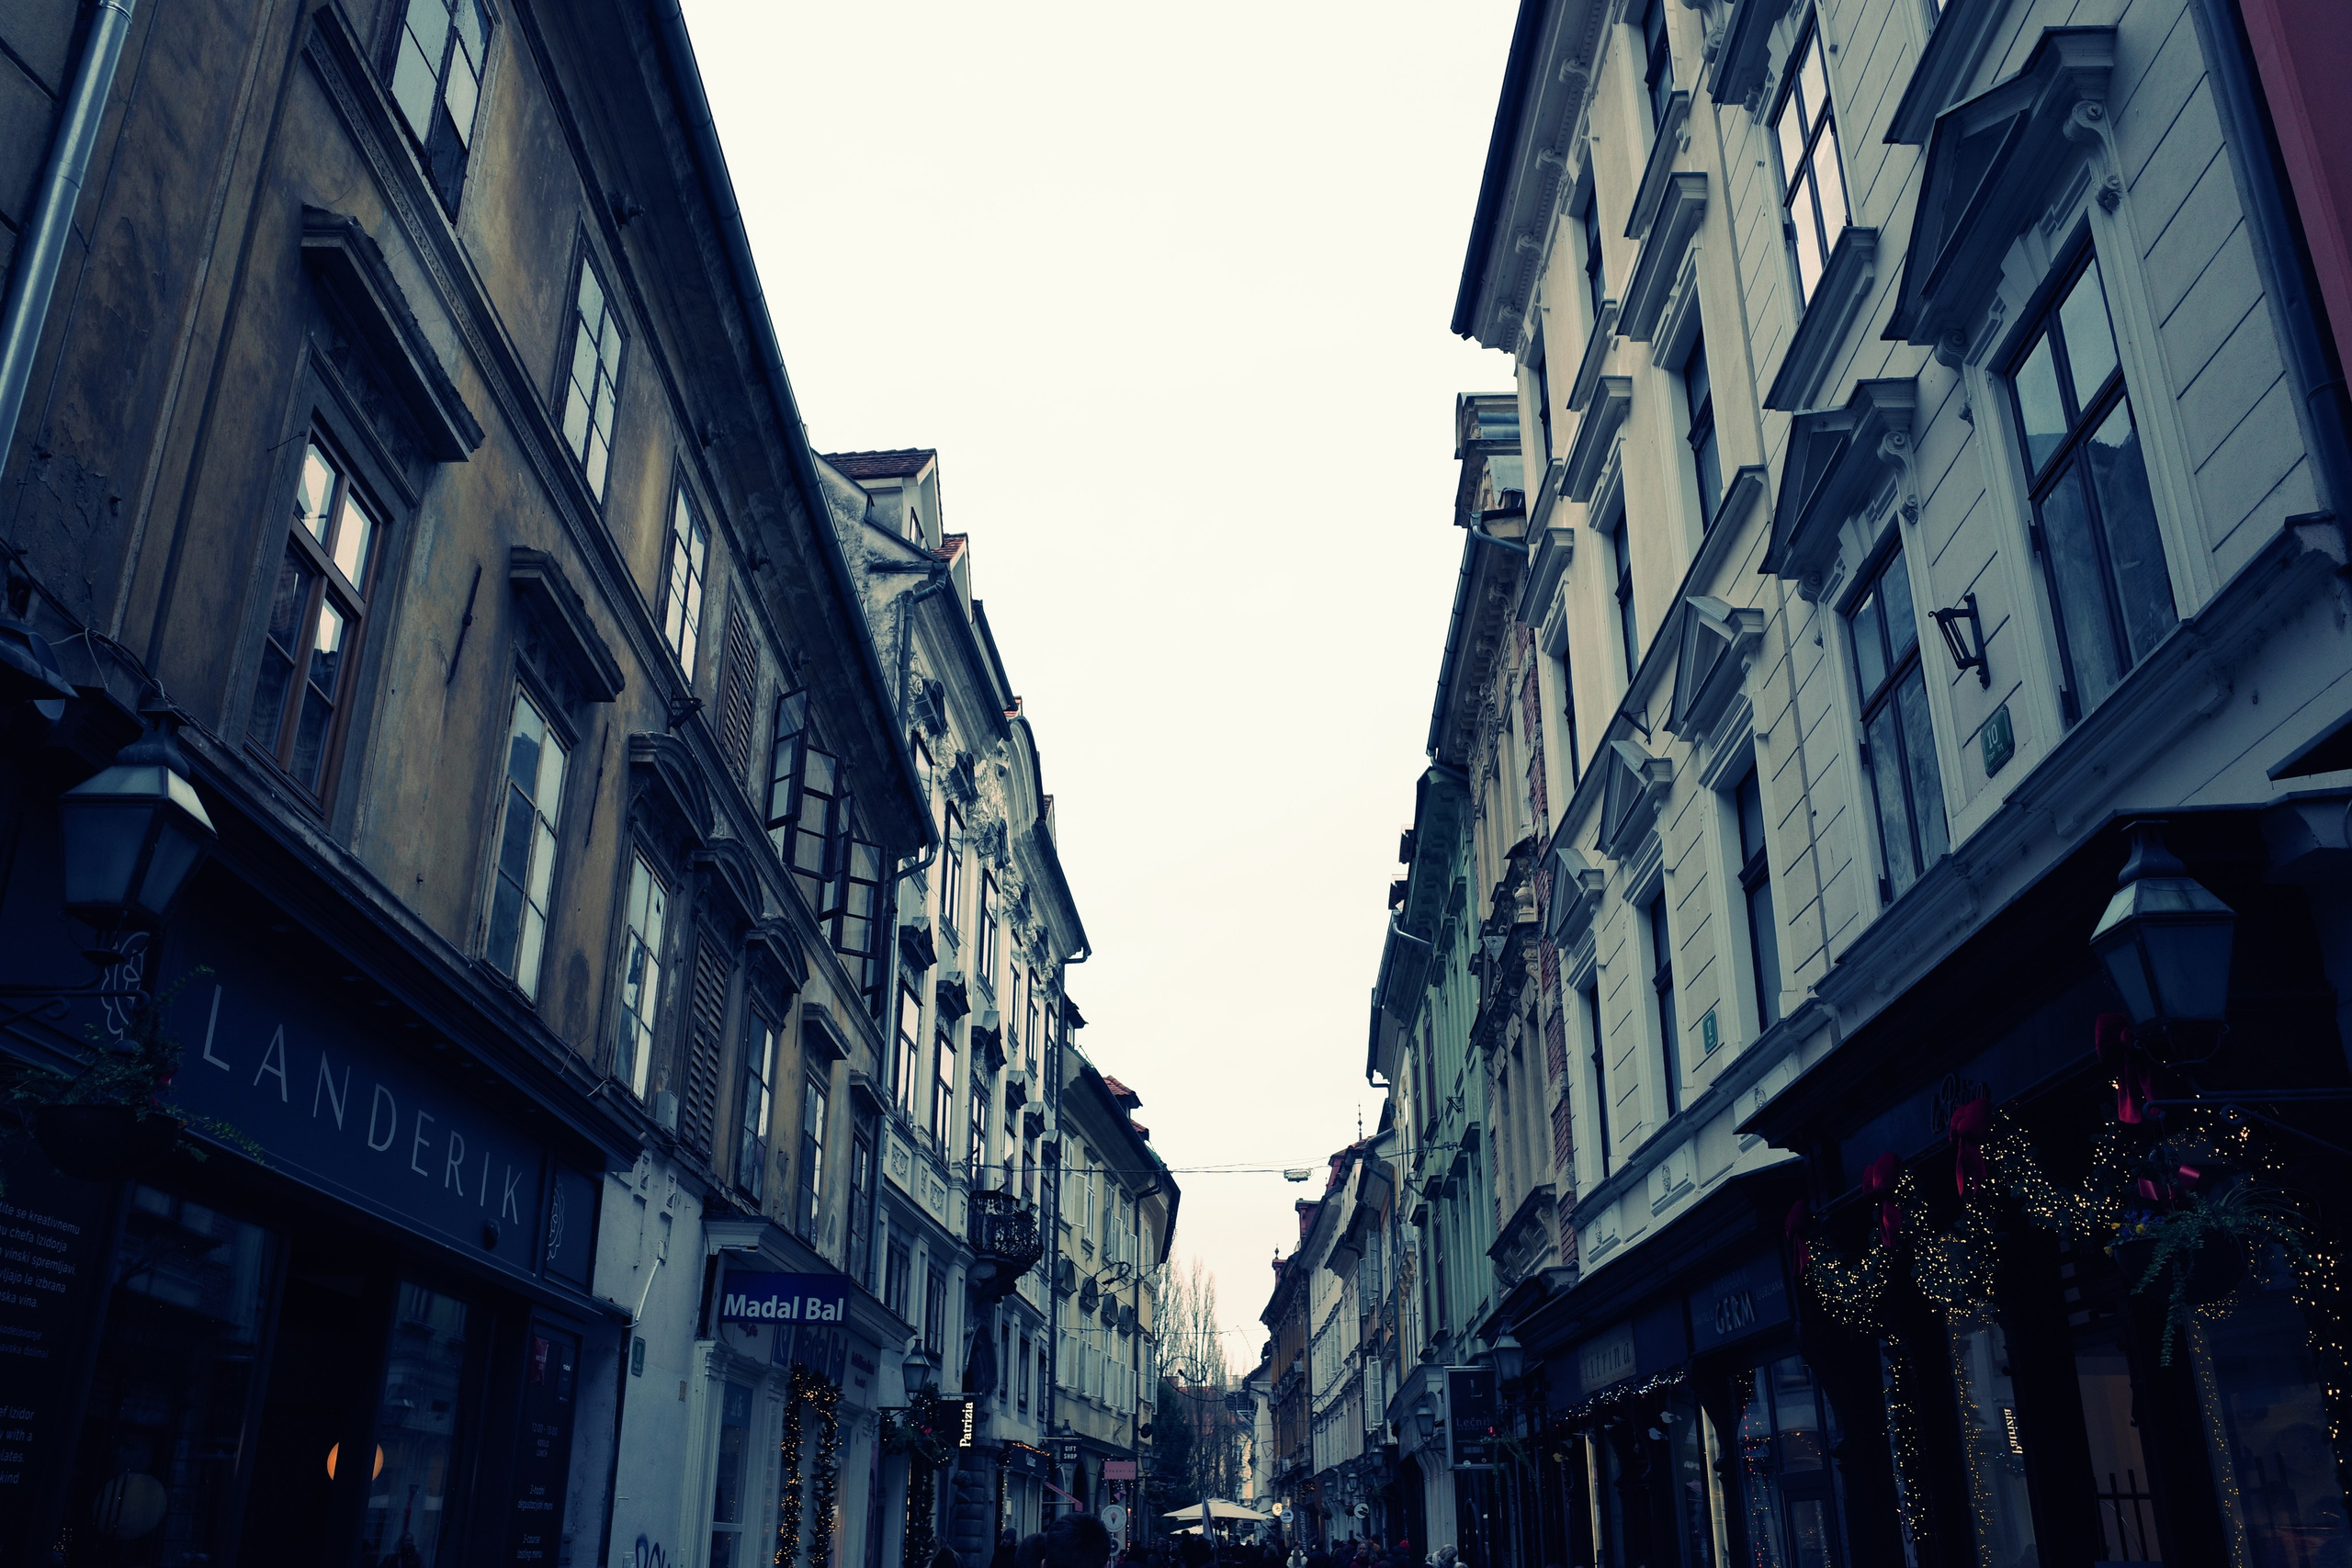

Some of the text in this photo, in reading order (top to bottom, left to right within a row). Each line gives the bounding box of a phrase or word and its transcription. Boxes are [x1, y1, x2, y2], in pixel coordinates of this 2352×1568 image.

[1987, 723, 1998, 749] 10
[201, 983, 523, 1226] LANDERIK
[16, 1208, 27, 1220] se
[28, 1209, 81, 1235] kreativnemu
[9, 1226, 34, 1243] chefa
[36, 1233, 67, 1253] Izidorja
[5, 1247, 30, 1264] vinski
[24, 1272, 33, 1285] le
[35, 1275, 66, 1293] izbrana
[723, 1293, 844, 1322] Madal Bal
[1715, 1290, 1756, 1336] GERM
[959, 1401, 974, 1449] Patrizia
